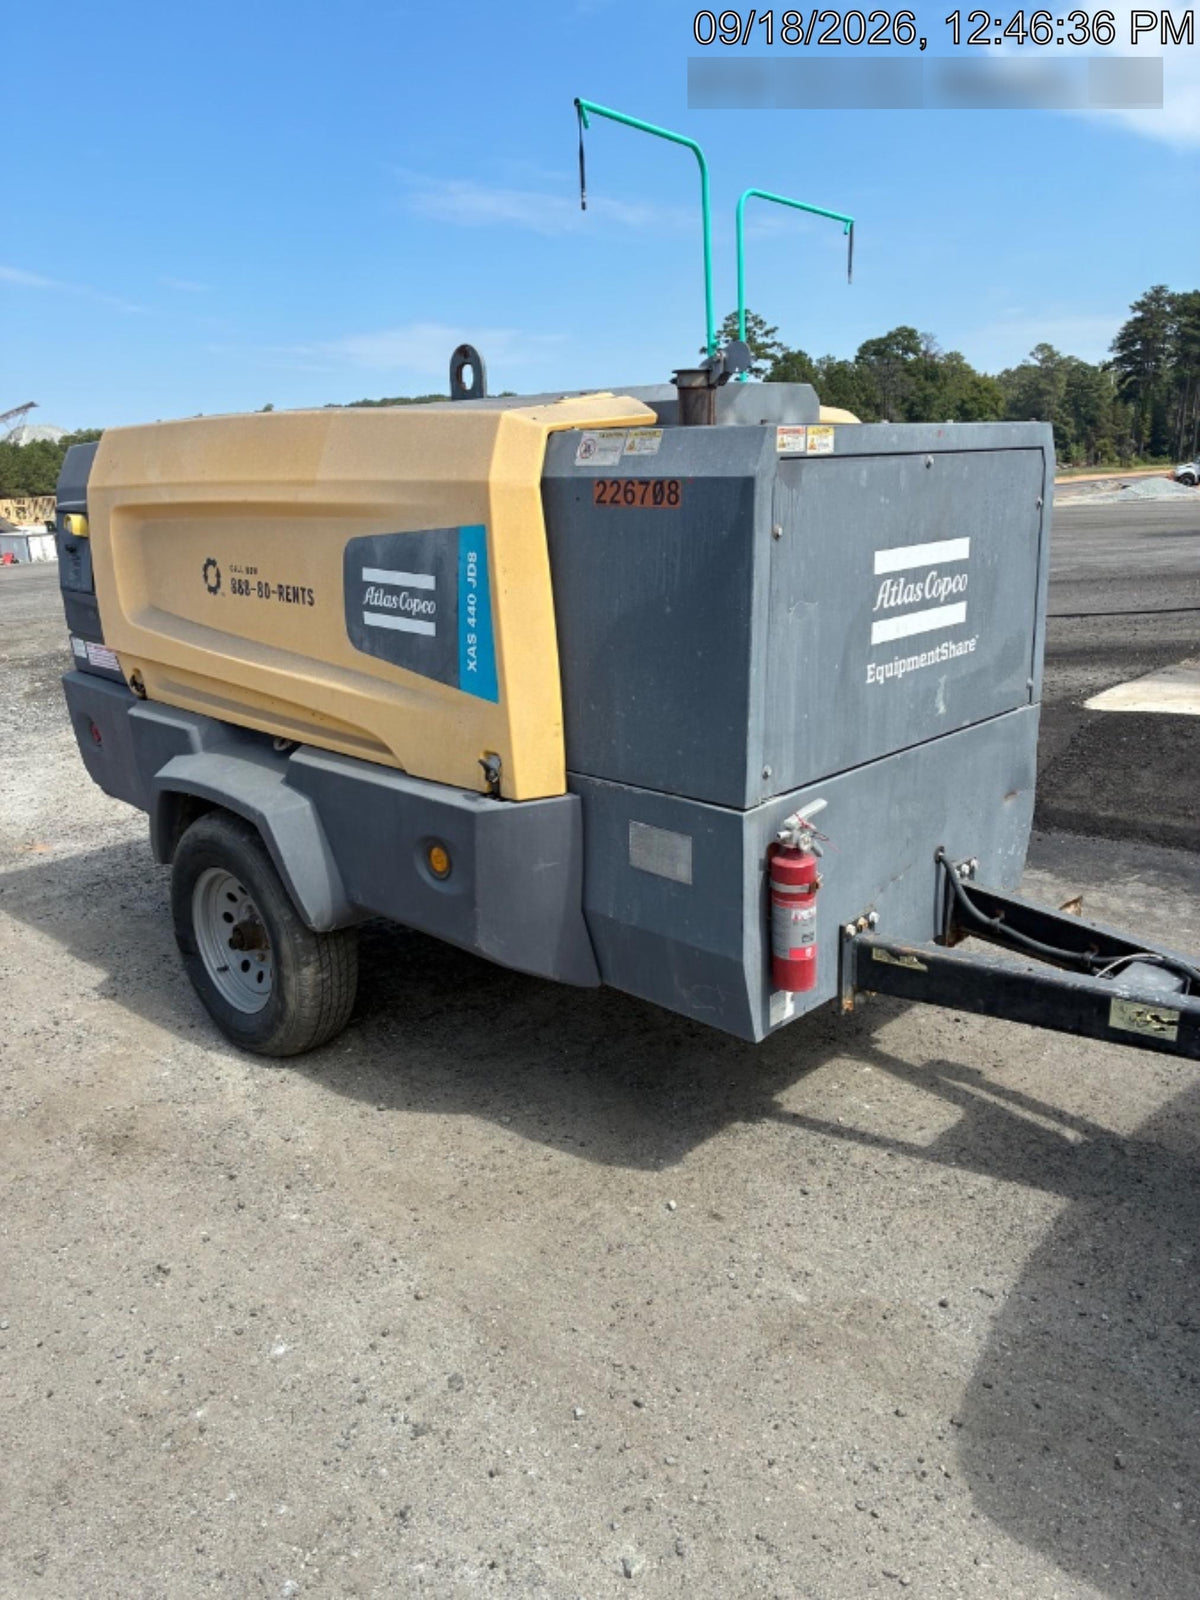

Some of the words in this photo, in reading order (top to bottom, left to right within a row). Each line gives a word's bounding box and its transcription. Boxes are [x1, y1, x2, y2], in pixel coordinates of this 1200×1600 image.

[595, 479, 680, 506] 226708
[466, 551, 478, 588] JD8
[230, 577, 315, 607] 888-80-RENTS
[363, 585, 398, 608] Atlas
[399, 591, 436, 615] Copco
[873, 576, 924, 612] Atlas
[924, 569, 968, 603] Copco
[466, 594, 478, 628] 440
[466, 633, 478, 672] XAS
[865, 637, 977, 685] EquipmentShare
